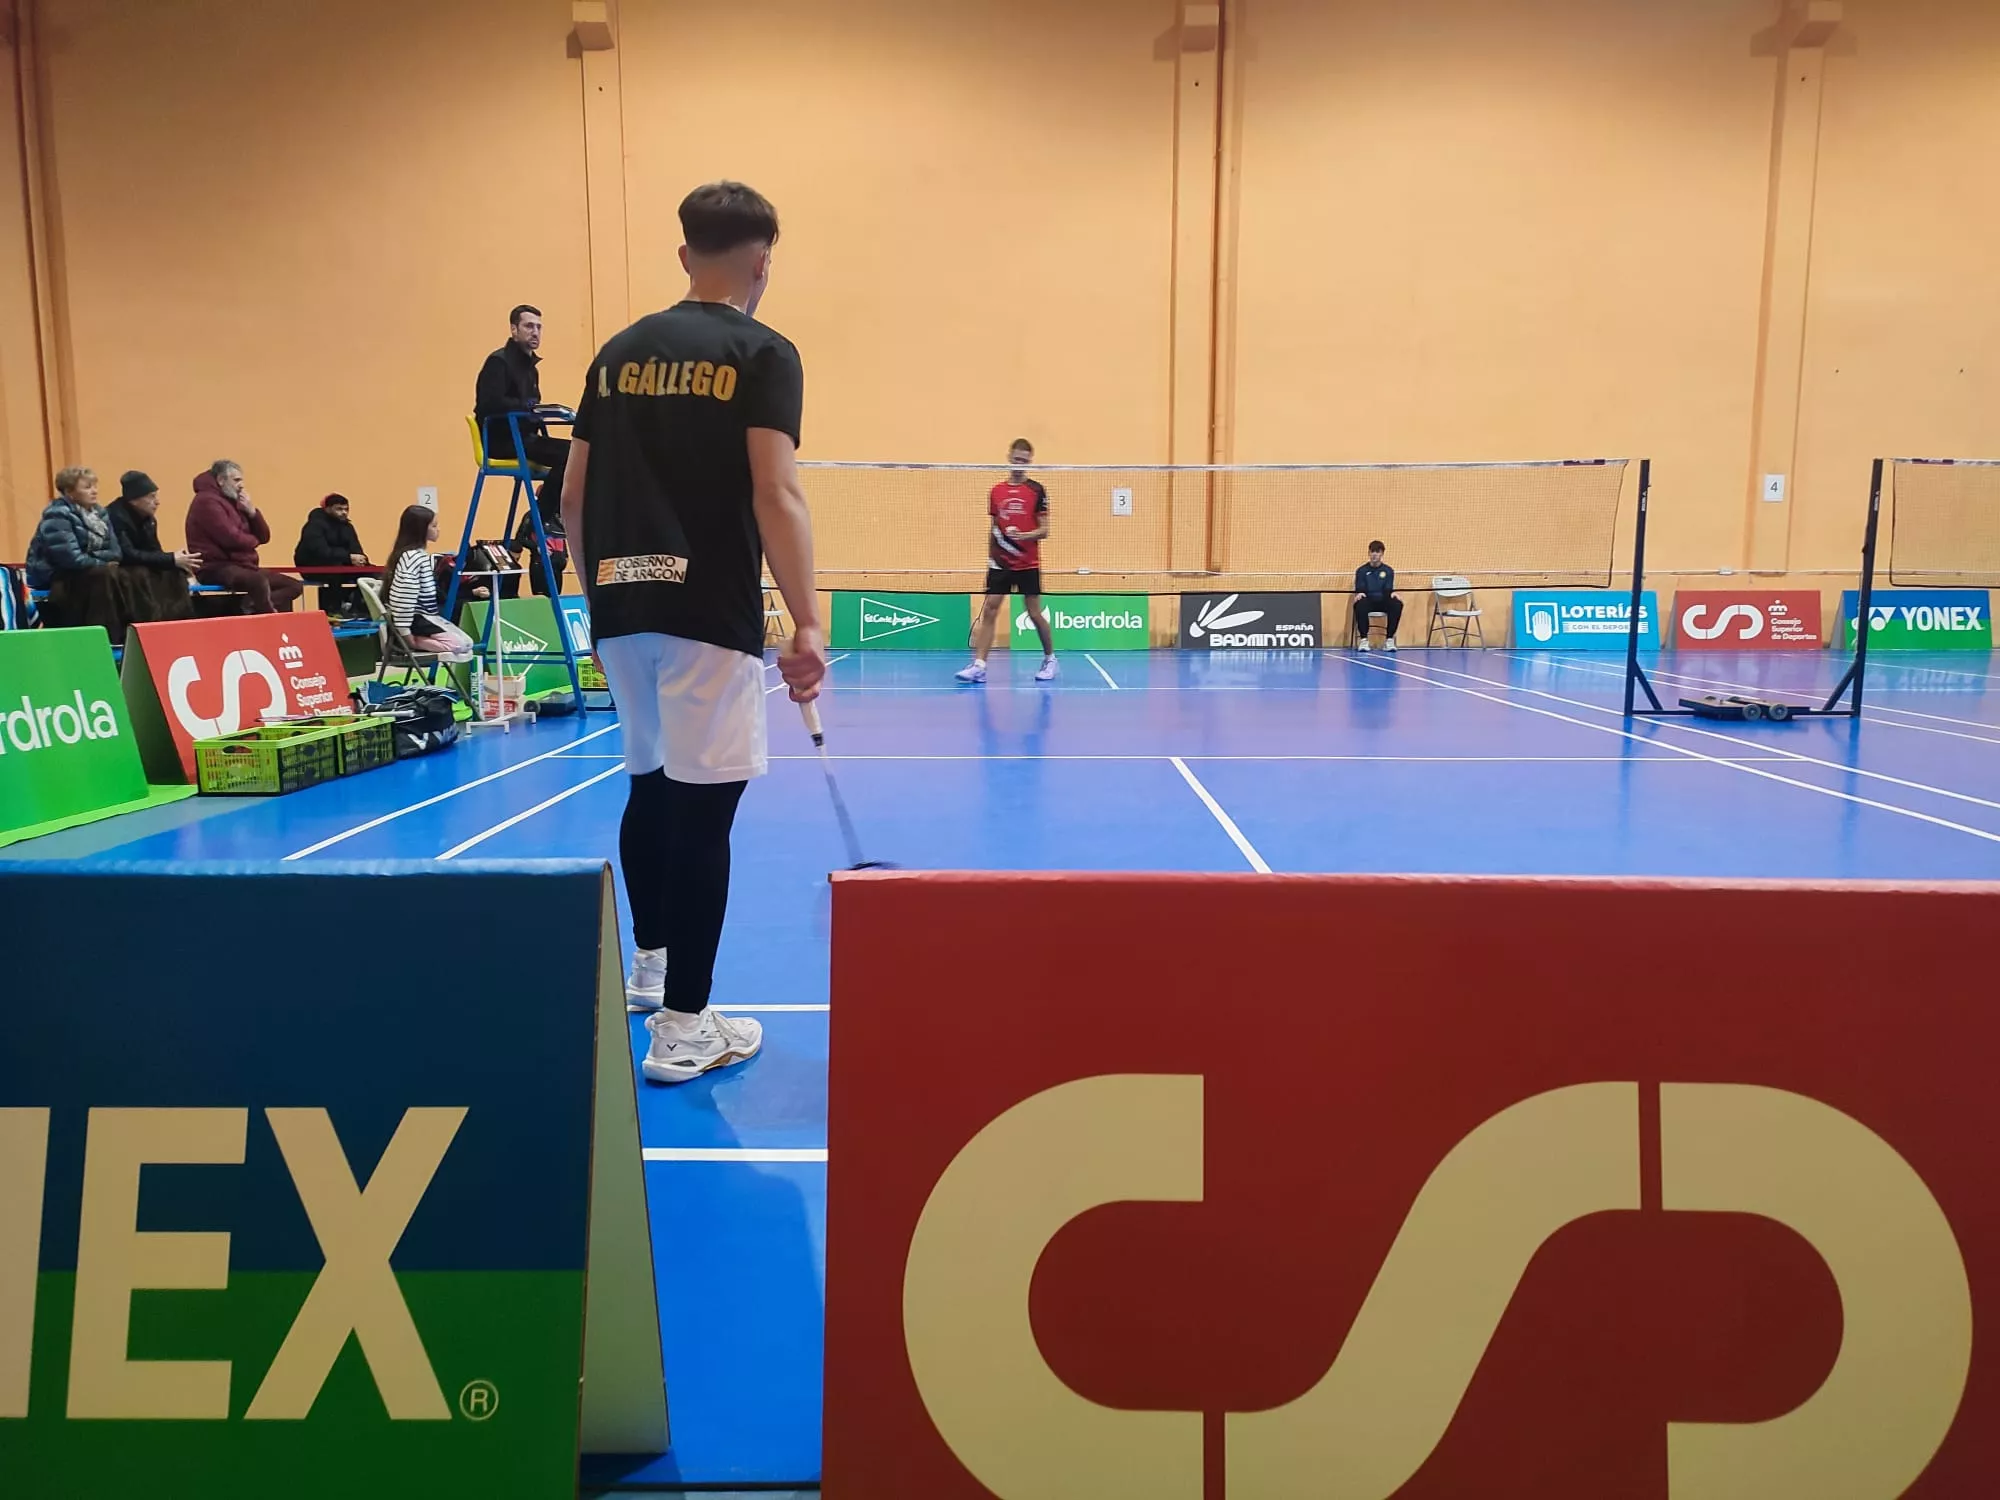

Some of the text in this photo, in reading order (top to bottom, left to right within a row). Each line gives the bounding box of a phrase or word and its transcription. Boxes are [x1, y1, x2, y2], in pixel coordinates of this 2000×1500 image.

[618, 356, 738, 401] GÁLLEGO
[1769, 481, 1779, 493] 4
[424, 493, 432, 505] 2
[1118, 495, 1127, 506] 3
[616, 556, 676, 570] GOBIERNO
[615, 571, 629, 582] DE
[1054, 610, 1143, 629] Iberdrola
[1900, 606, 1982, 631] YONEX
[1275, 623, 1315, 631] ESPAÑA
[1209, 633, 1315, 647] BADMINTON
[290, 672, 327, 690] Consejo
[295, 689, 334, 707] Superior
